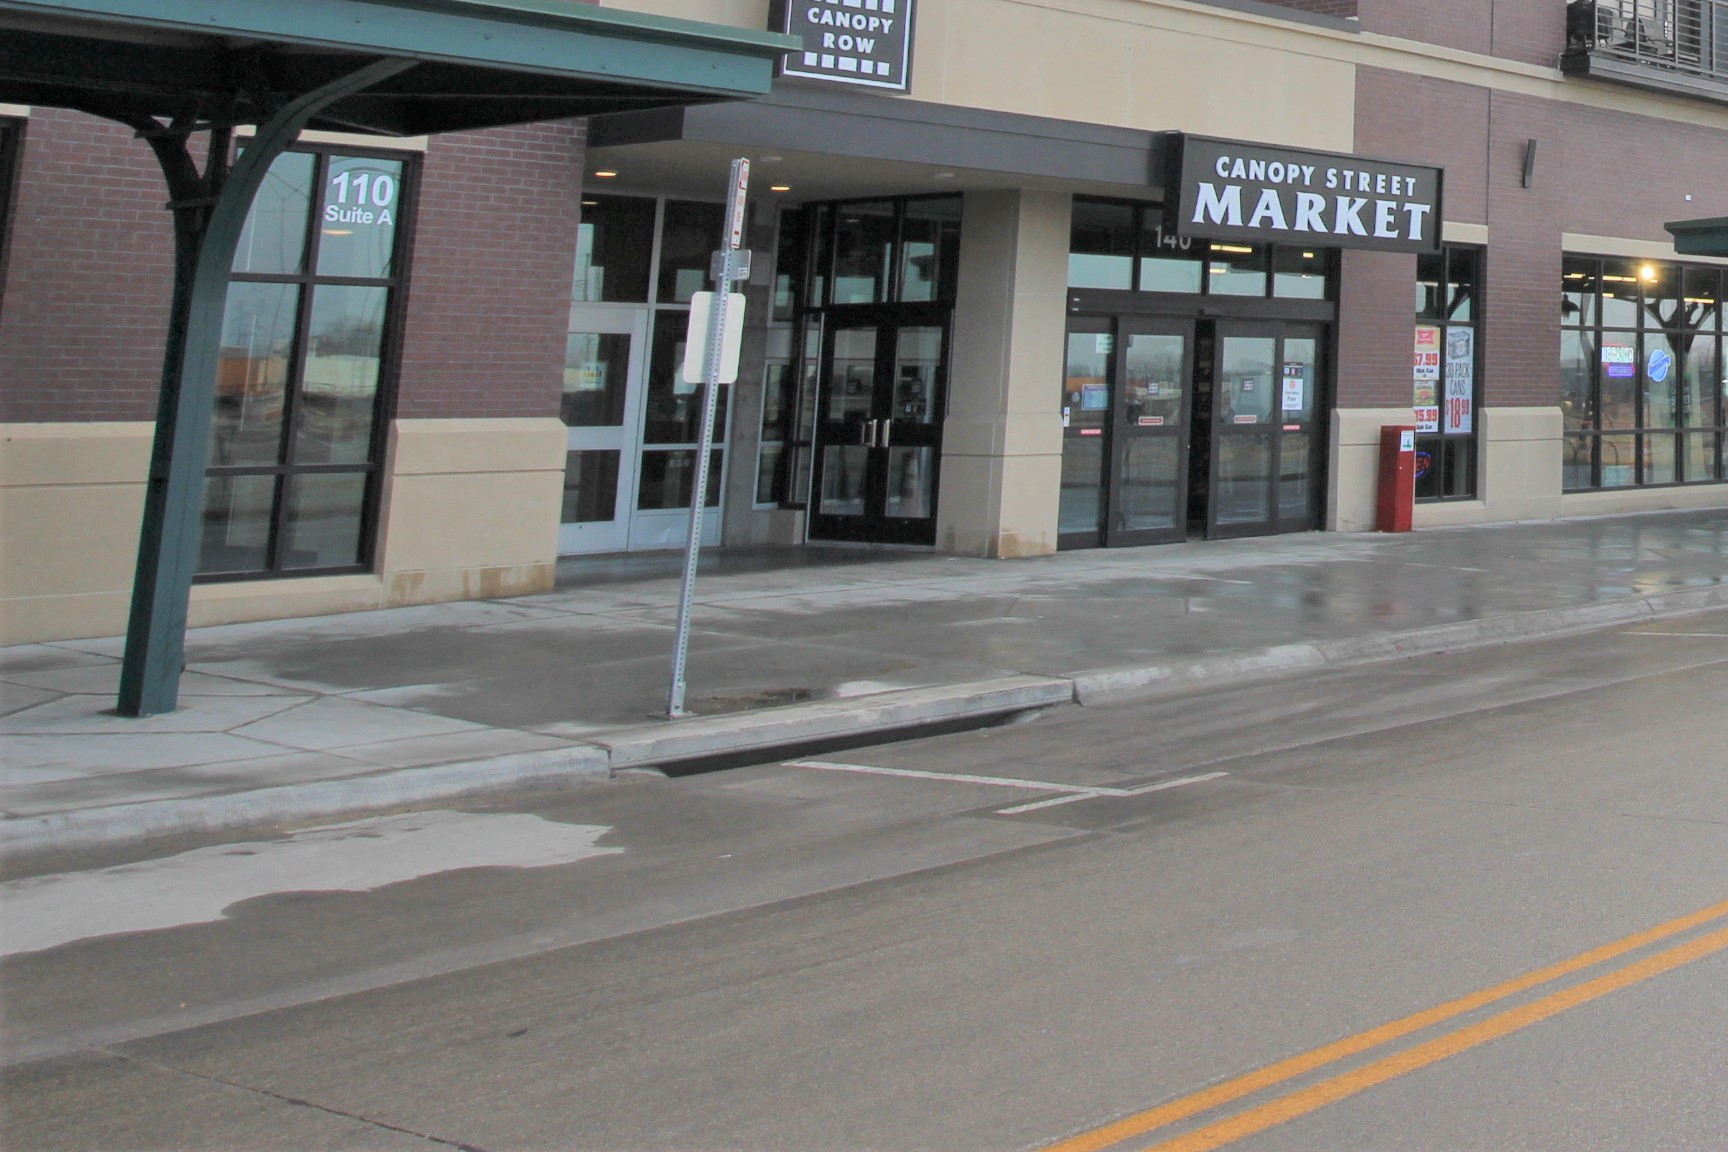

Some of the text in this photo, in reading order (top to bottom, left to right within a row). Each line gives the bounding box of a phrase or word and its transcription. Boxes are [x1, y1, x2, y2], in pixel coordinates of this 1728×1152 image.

[807, 7, 893, 34] CANOPY
[823, 32, 875, 54] ROW
[1215, 155, 1416, 197] CANOPY STREET
[332, 171, 394, 207] 110
[324, 204, 393, 225] Suite A
[1192, 182, 1431, 241] MARKET
[1455, 362, 1470, 379] PACK
[1450, 379, 1466, 396] CANS
